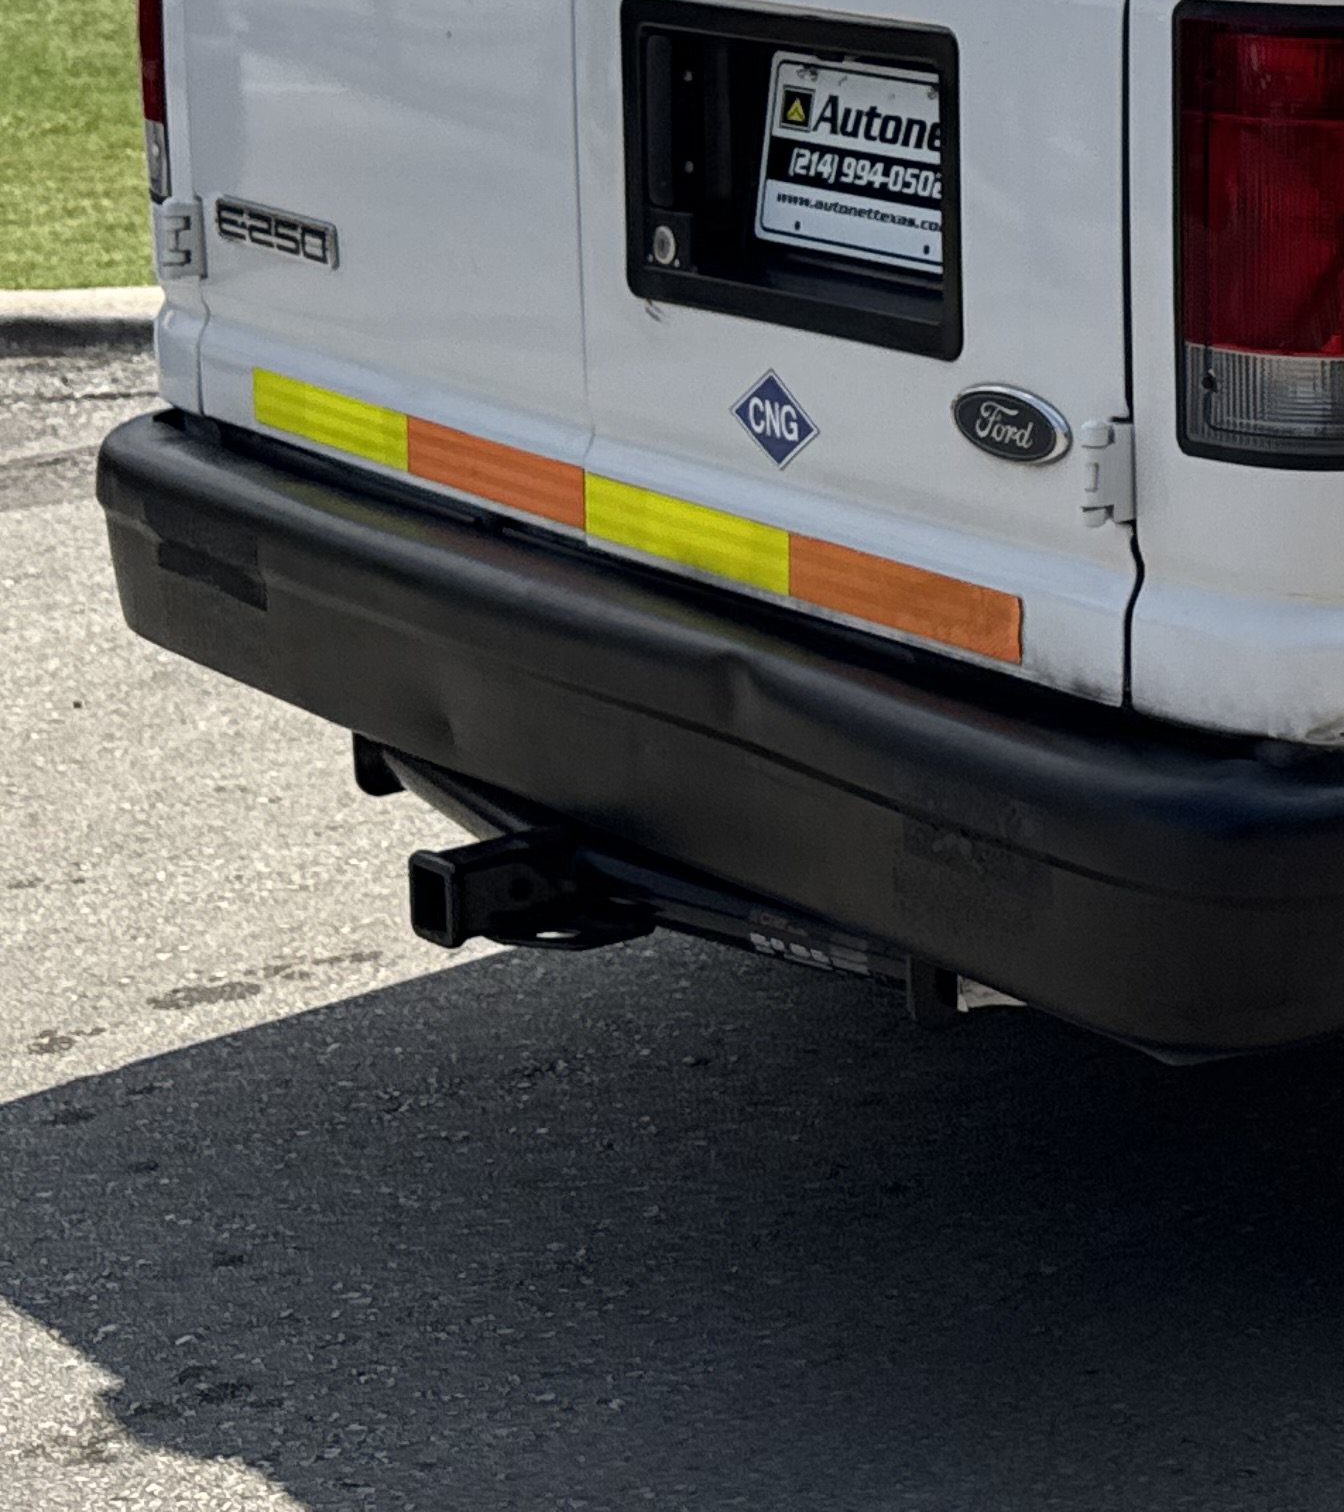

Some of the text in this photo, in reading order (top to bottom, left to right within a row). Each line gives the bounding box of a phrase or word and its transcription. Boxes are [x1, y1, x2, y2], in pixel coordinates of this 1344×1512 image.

[789, 147, 839, 185] (214)
[776, 193, 942, 233] www.autonettexas.co
[747, 396, 800, 443] CNG
[975, 400, 1034, 449] Ford
